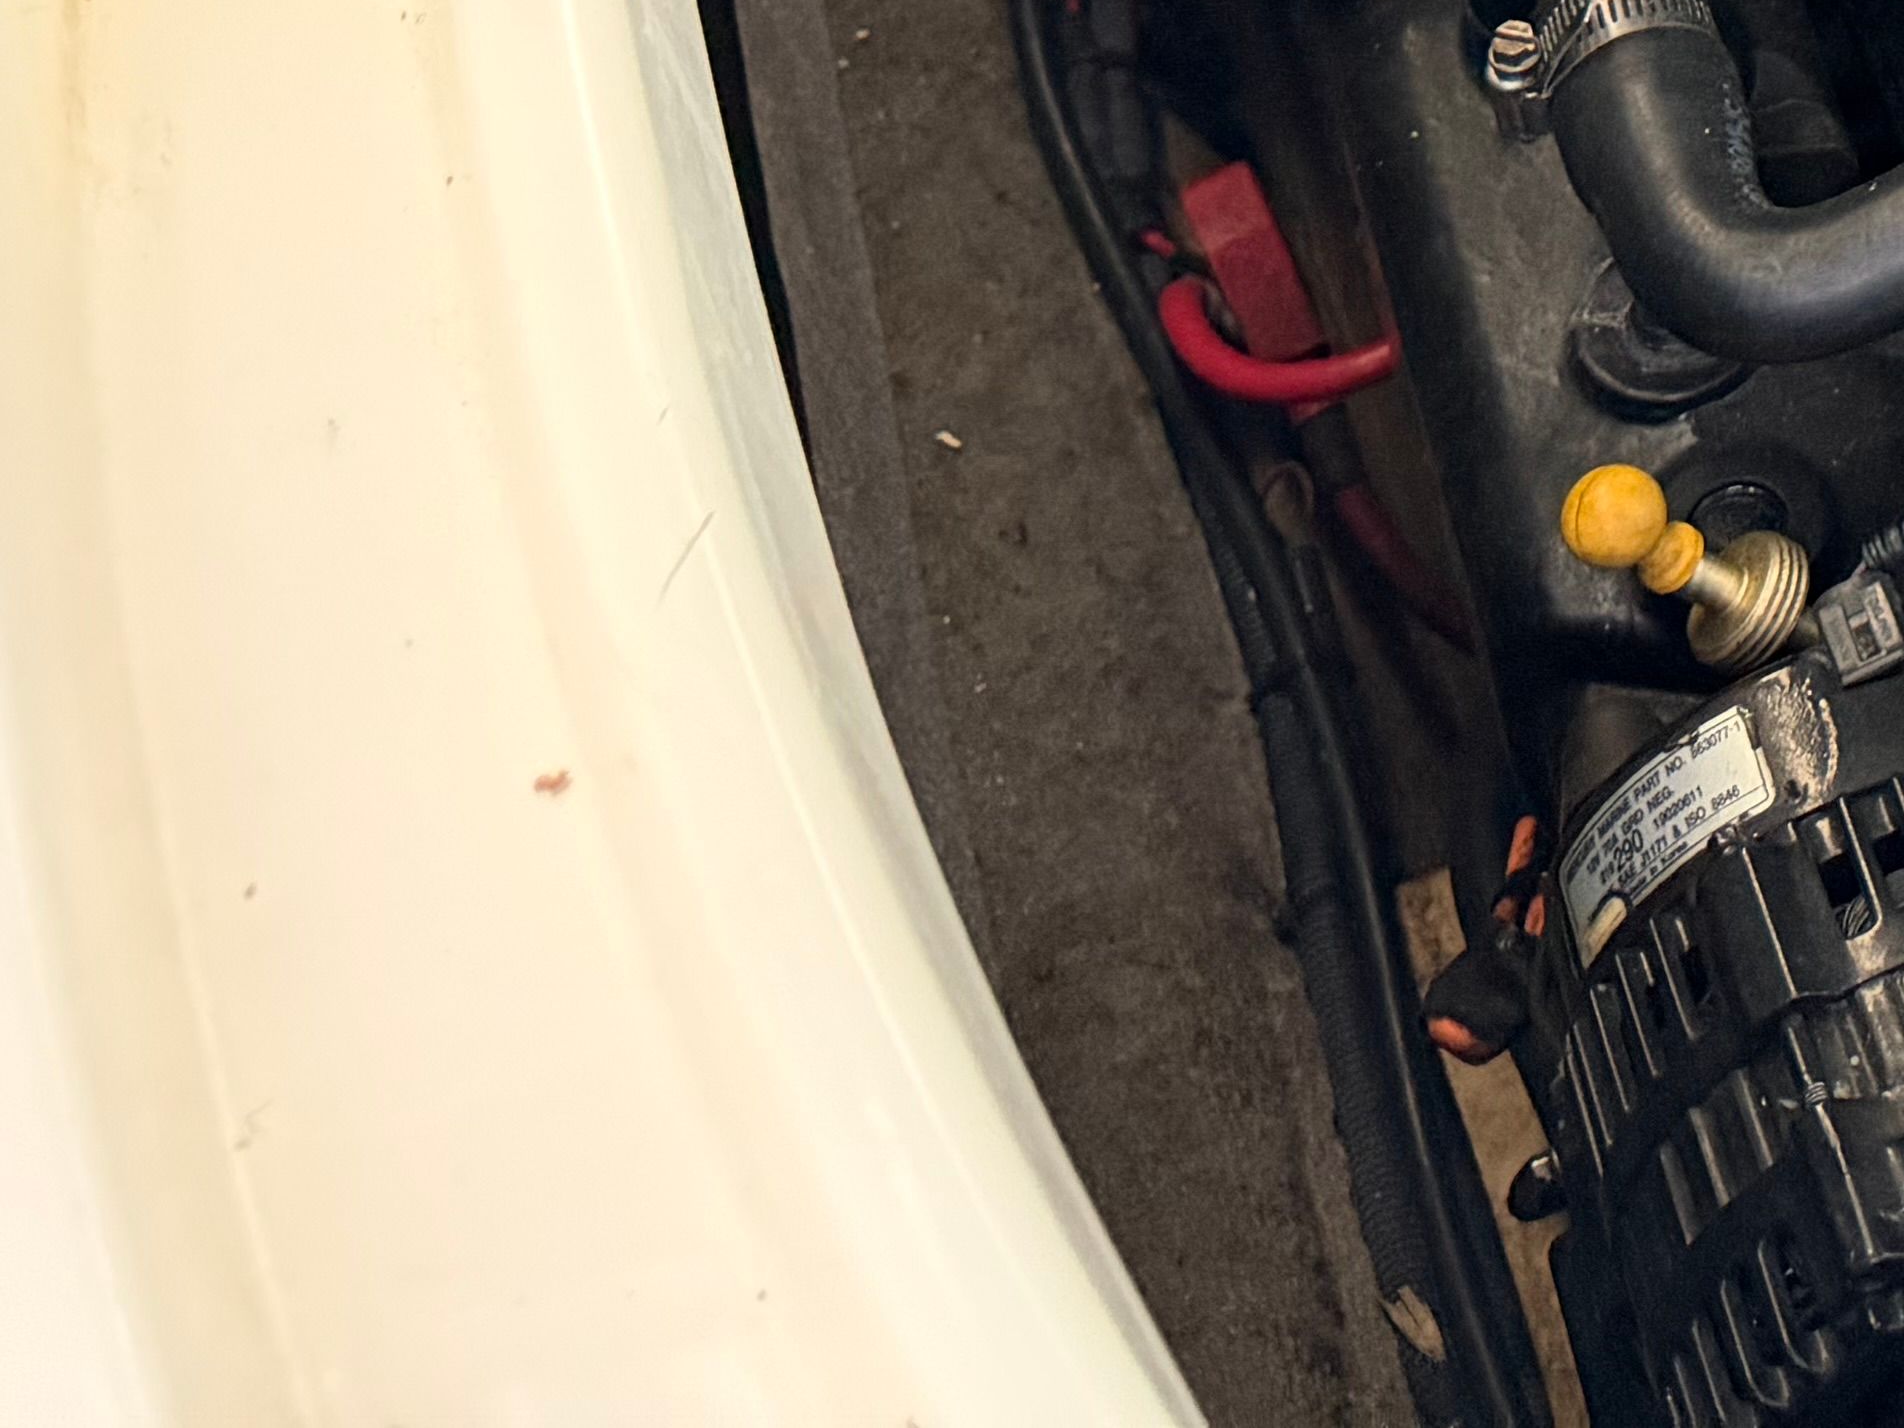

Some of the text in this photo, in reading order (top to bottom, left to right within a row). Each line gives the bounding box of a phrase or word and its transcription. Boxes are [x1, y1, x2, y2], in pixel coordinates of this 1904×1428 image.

[1634, 771, 1659, 801] PART
[1665, 757, 1685, 776] NO.
[1684, 806, 1706, 828] ISO
[1610, 829, 1643, 871] 290
